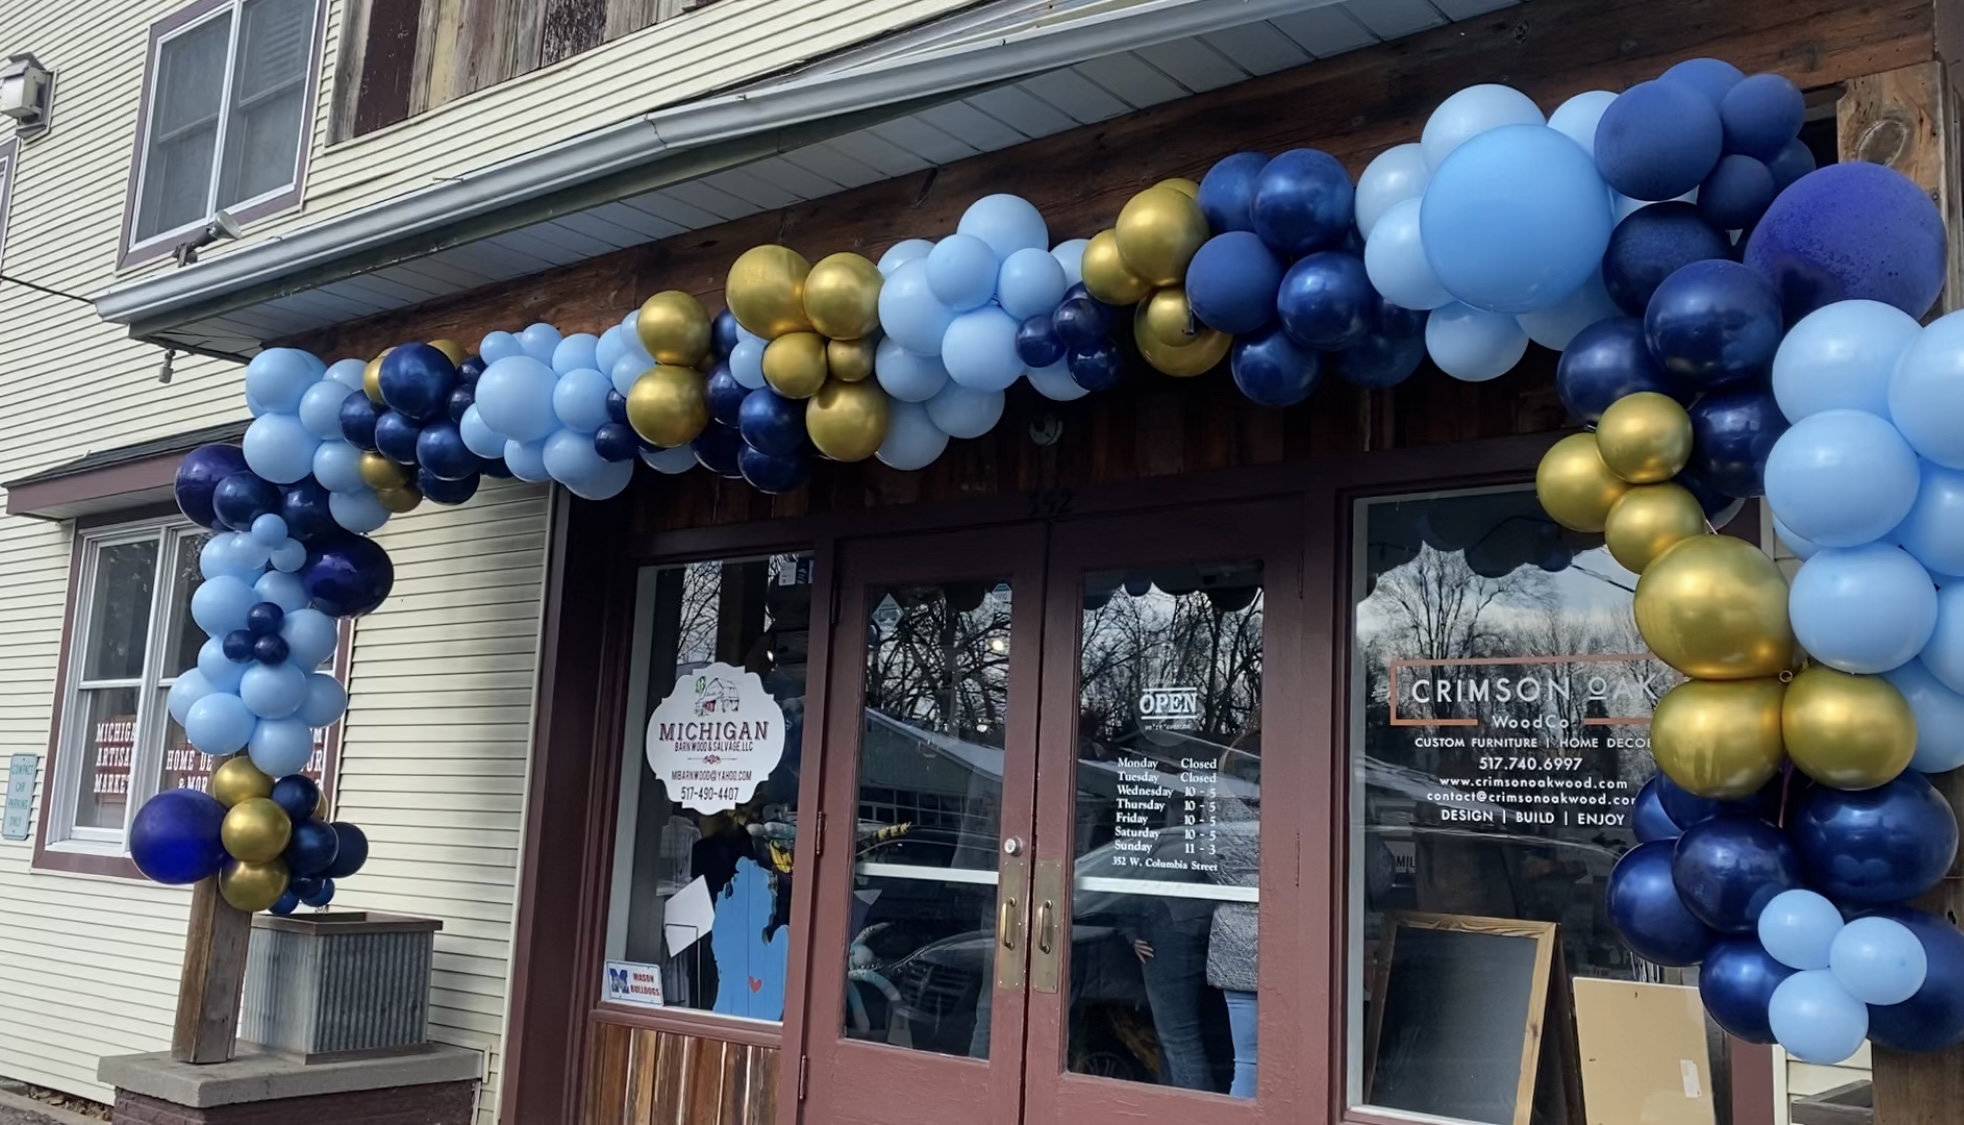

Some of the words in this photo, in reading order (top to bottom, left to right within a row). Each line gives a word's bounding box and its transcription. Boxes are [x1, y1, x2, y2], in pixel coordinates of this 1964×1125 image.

[1411, 677, 1570, 703] CRIMSON
[1588, 673, 1658, 700] OAK
[1139, 692, 1198, 715] OPEN
[1492, 714, 1569, 729] WoodCo
[659, 721, 769, 741] MICHIGAN
[1415, 737, 1465, 748] CUSTOM
[1471, 737, 1538, 748] FURNITURE
[1560, 737, 1599, 749] HOME
[95, 746, 132, 768] ARTISA
[165, 749, 196, 771] HOME
[1117, 757, 1159, 770] Monday
[1181, 758, 1217, 769] Closed
[1479, 757, 1583, 770] 517.740.6997
[1117, 771, 1160, 784] Tuesday
[1180, 772, 1217, 783] Closed
[1439, 776, 1628, 789] www.crimsonoakwood.com
[681, 786, 739, 800] 517-490-4407
[1116, 784, 1174, 798] Wednesday
[1184, 786, 1196, 797] 10
[1209, 787, 1217, 799] 5
[1116, 798, 1166, 813] Thursday
[1184, 800, 1196, 811] 10
[1209, 801, 1216, 813] 5
[1115, 812, 1149, 826] Friday
[1184, 814, 1196, 826] 10
[1209, 815, 1216, 827] 5
[1441, 810, 1494, 822] DESIGN
[1516, 811, 1555, 824] BUILD
[1578, 812, 1625, 826] ENJOY
[1114, 826, 1161, 840] Saturday
[1184, 828, 1196, 840] 10
[1209, 830, 1217, 842] 5
[1114, 840, 1153, 854] Sunday
[1184, 842, 1195, 854] 11
[1209, 844, 1216, 856] 3
[1111, 856, 1127, 867] 352
[1129, 857, 1143, 867] W.
[1145, 857, 1188, 870] Columbia
[1191, 860, 1218, 872] Street
[633, 972, 655, 983] MASON
[630, 984, 660, 997] BULLDOGS
